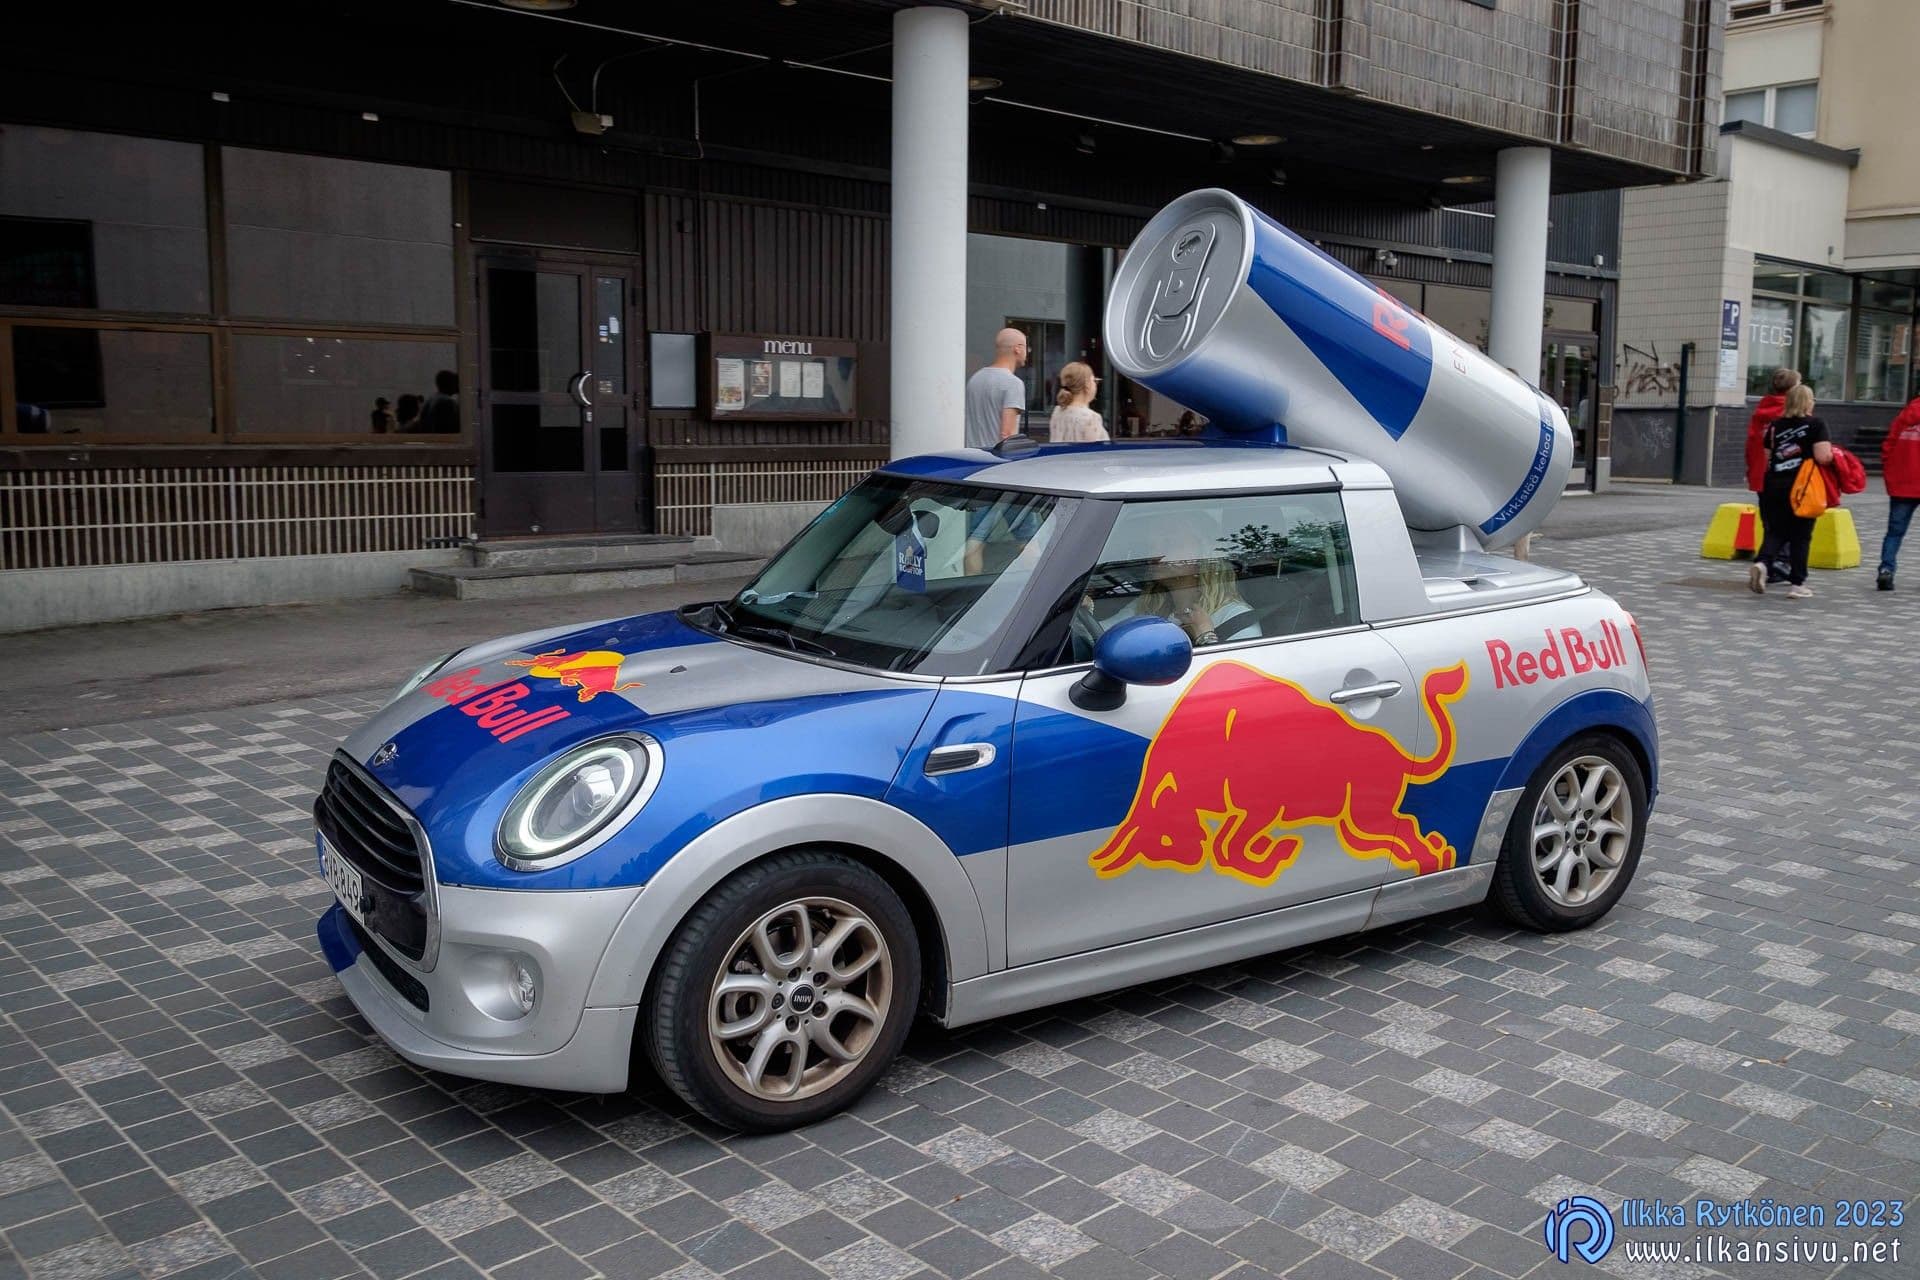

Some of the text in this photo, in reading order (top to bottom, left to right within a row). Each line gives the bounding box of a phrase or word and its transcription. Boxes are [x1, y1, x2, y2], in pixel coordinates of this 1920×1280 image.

[1731, 303, 1740, 325] P
[764, 340, 813, 355] menu
[1535, 433, 1553, 474] kehoa
[899, 552, 922, 568] RLY
[1485, 619, 1627, 689] Red Bull
[420, 667, 572, 744] Red Bull
